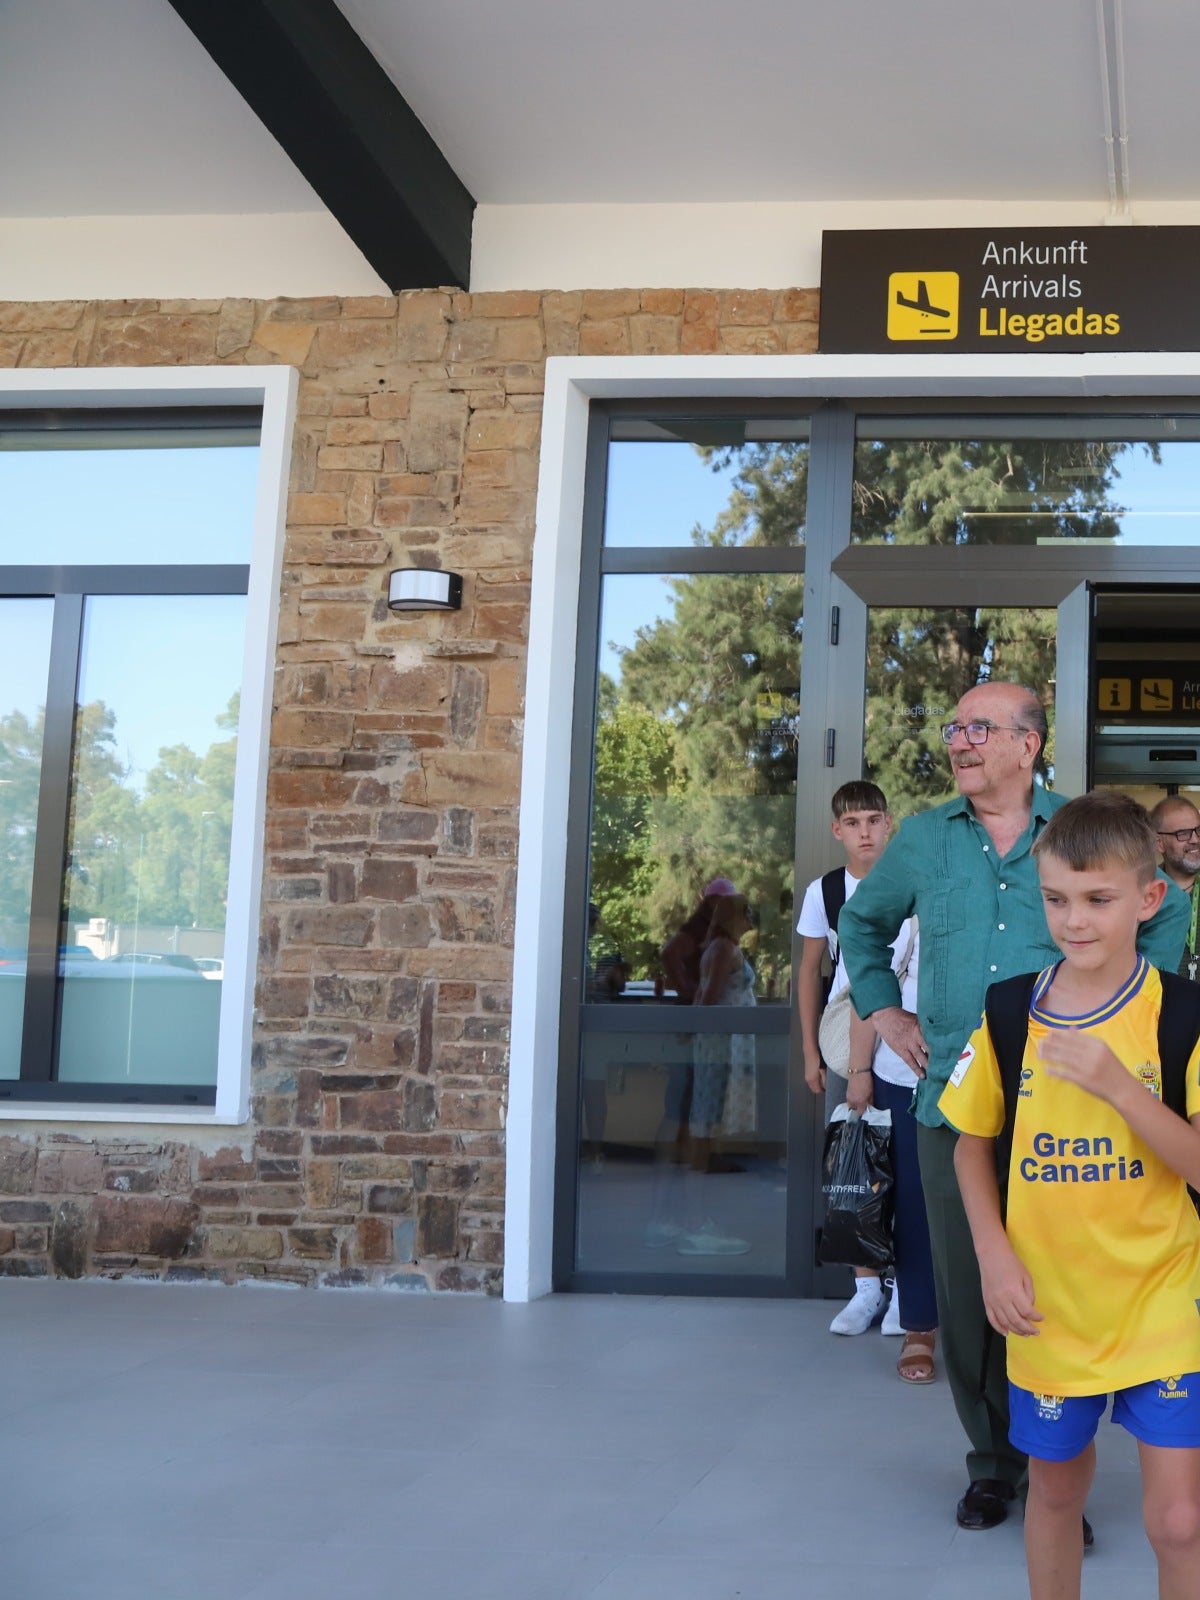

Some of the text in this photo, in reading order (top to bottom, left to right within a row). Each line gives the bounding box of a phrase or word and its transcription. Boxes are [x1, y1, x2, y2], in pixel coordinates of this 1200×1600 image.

[981, 240, 1088, 265] Ankunft
[981, 274, 1082, 299] Arrivals
[980, 307, 1120, 342] Llegadas
[894, 705, 945, 717] Llegadas
[1033, 1132, 1113, 1157] Gran
[1020, 1157, 1145, 1183] Canaria
[1159, 1388, 1187, 1398] hummel
